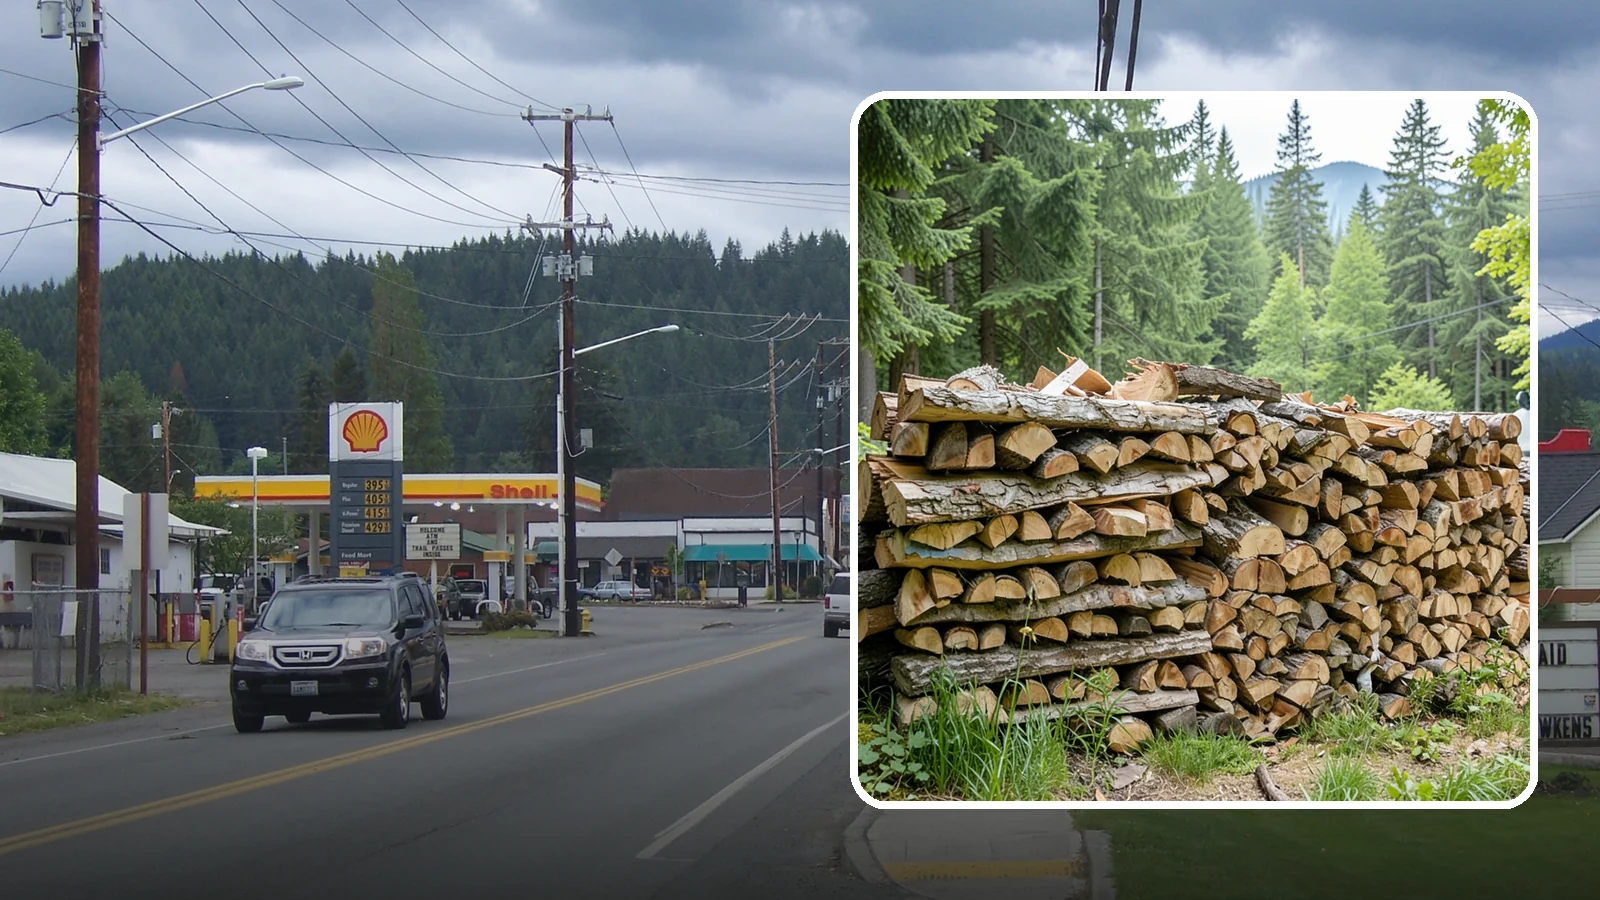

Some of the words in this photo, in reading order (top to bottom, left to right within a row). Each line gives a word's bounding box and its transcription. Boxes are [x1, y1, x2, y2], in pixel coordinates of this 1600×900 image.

[366, 480, 383, 490] 395
[490, 484, 547, 498] Shell
[366, 494, 383, 504] 405
[366, 508, 383, 518] 415
[366, 522, 383, 532] 429
